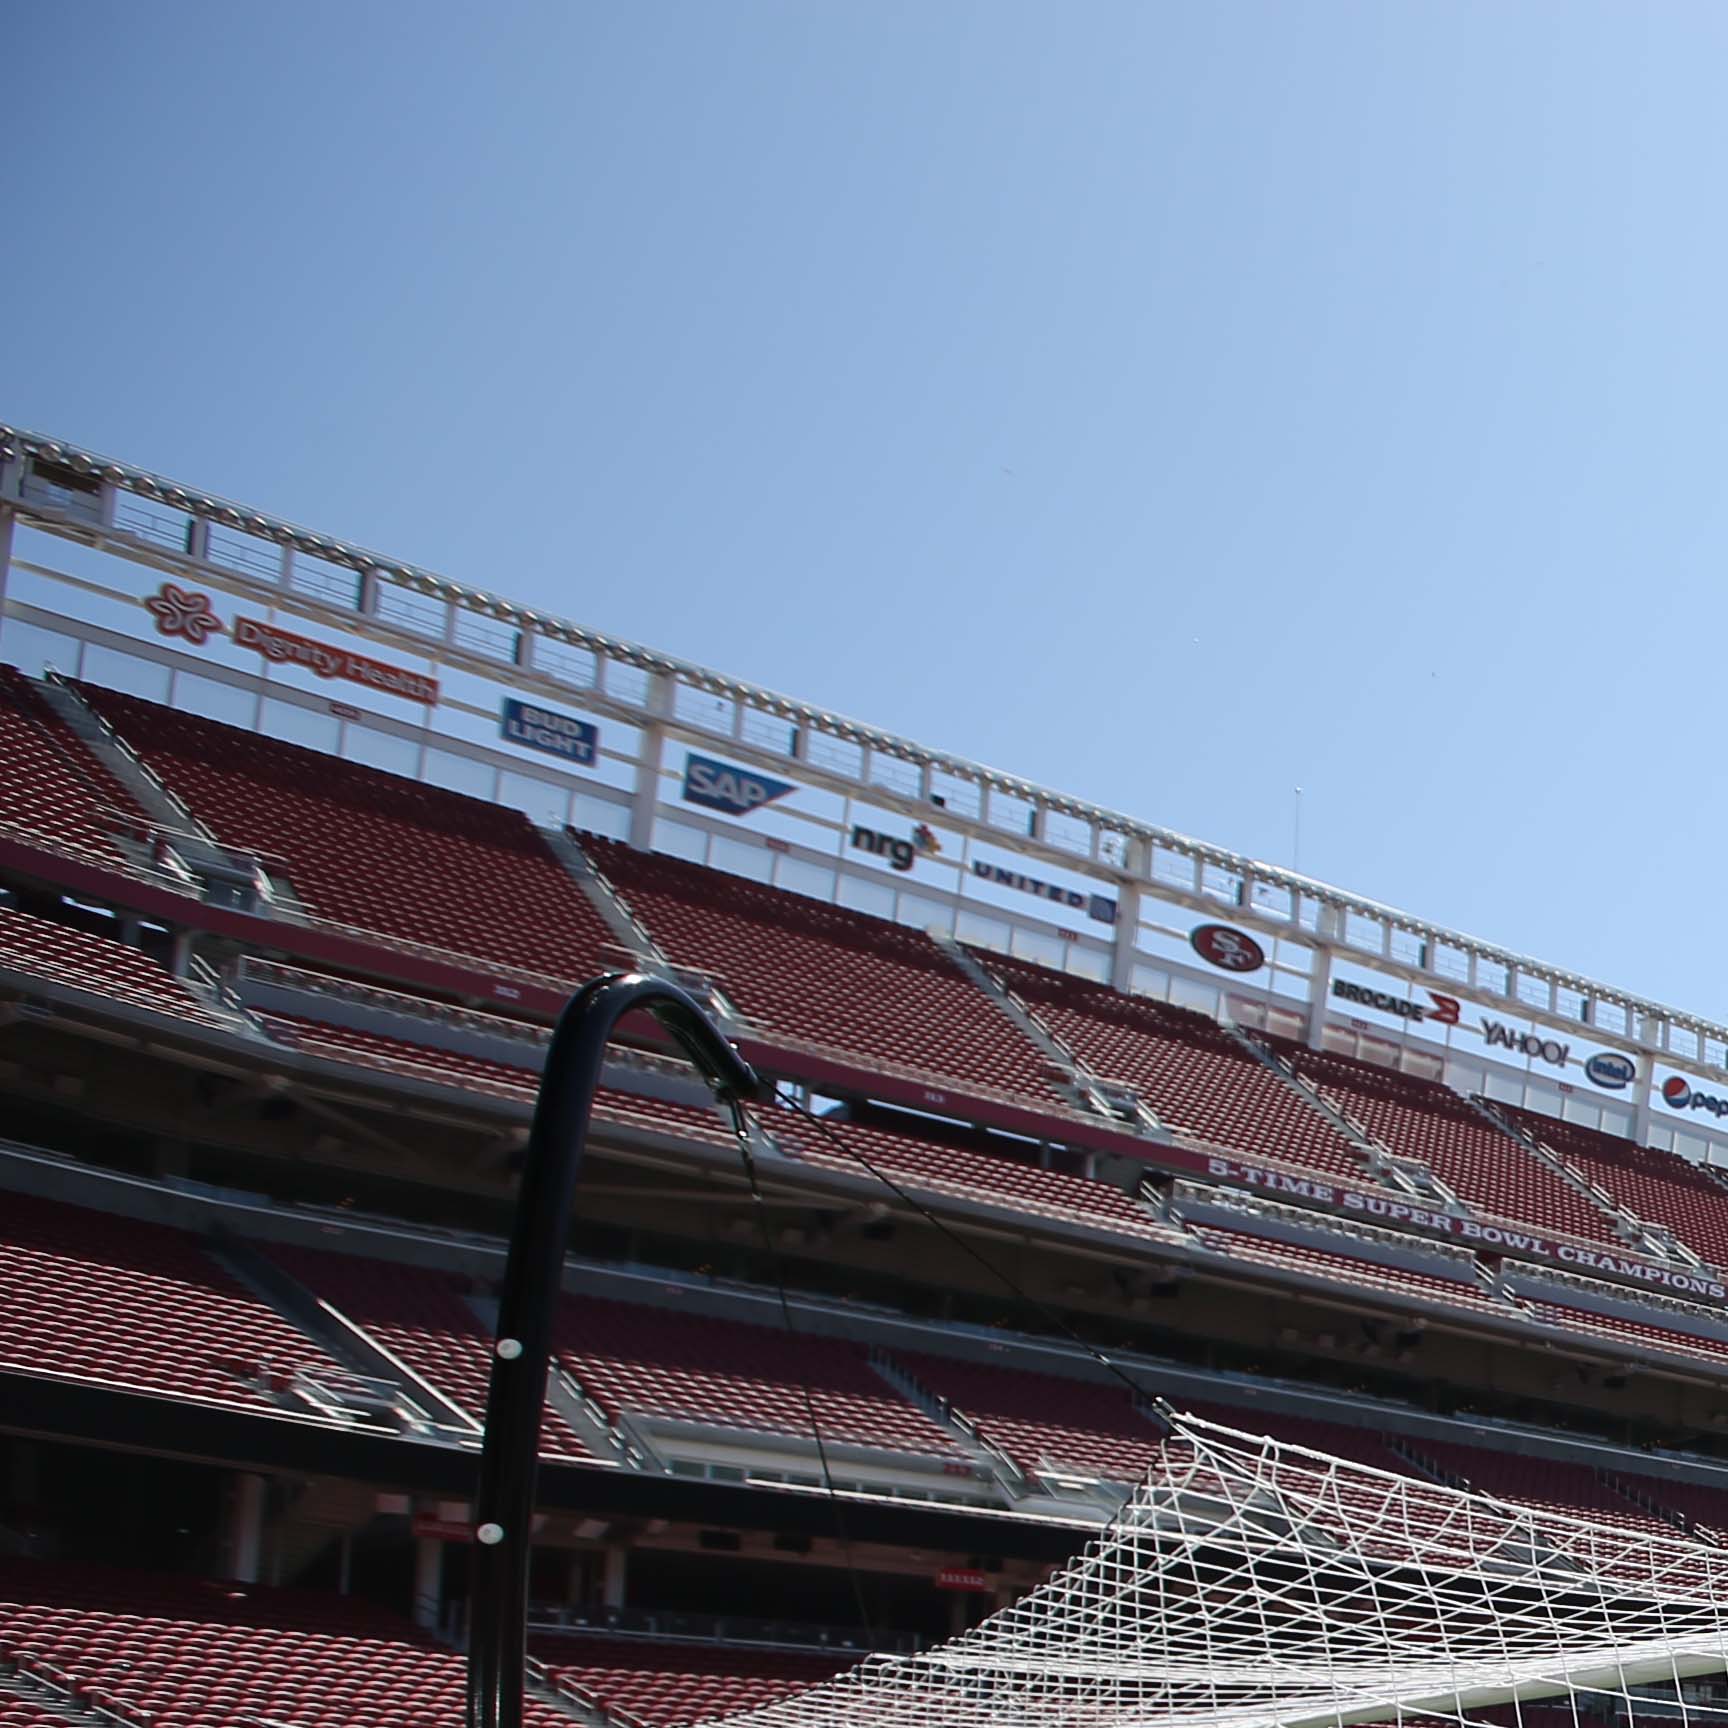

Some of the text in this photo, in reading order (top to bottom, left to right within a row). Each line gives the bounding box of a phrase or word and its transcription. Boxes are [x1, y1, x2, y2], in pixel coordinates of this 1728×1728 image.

[241, 622, 434, 698] Dignity Health
[508, 722, 592, 757] LIGHT
[522, 705, 583, 738] BUD
[689, 763, 769, 806] SAP
[853, 825, 914, 870] nrg
[974, 860, 1085, 908] UNITED
[1333, 978, 1424, 1022] BROCADE
[1481, 1016, 1571, 1068] YAHOO!
[1208, 1158, 1726, 1299] 5-TIME SUPER BOWL CHAMPIONS
